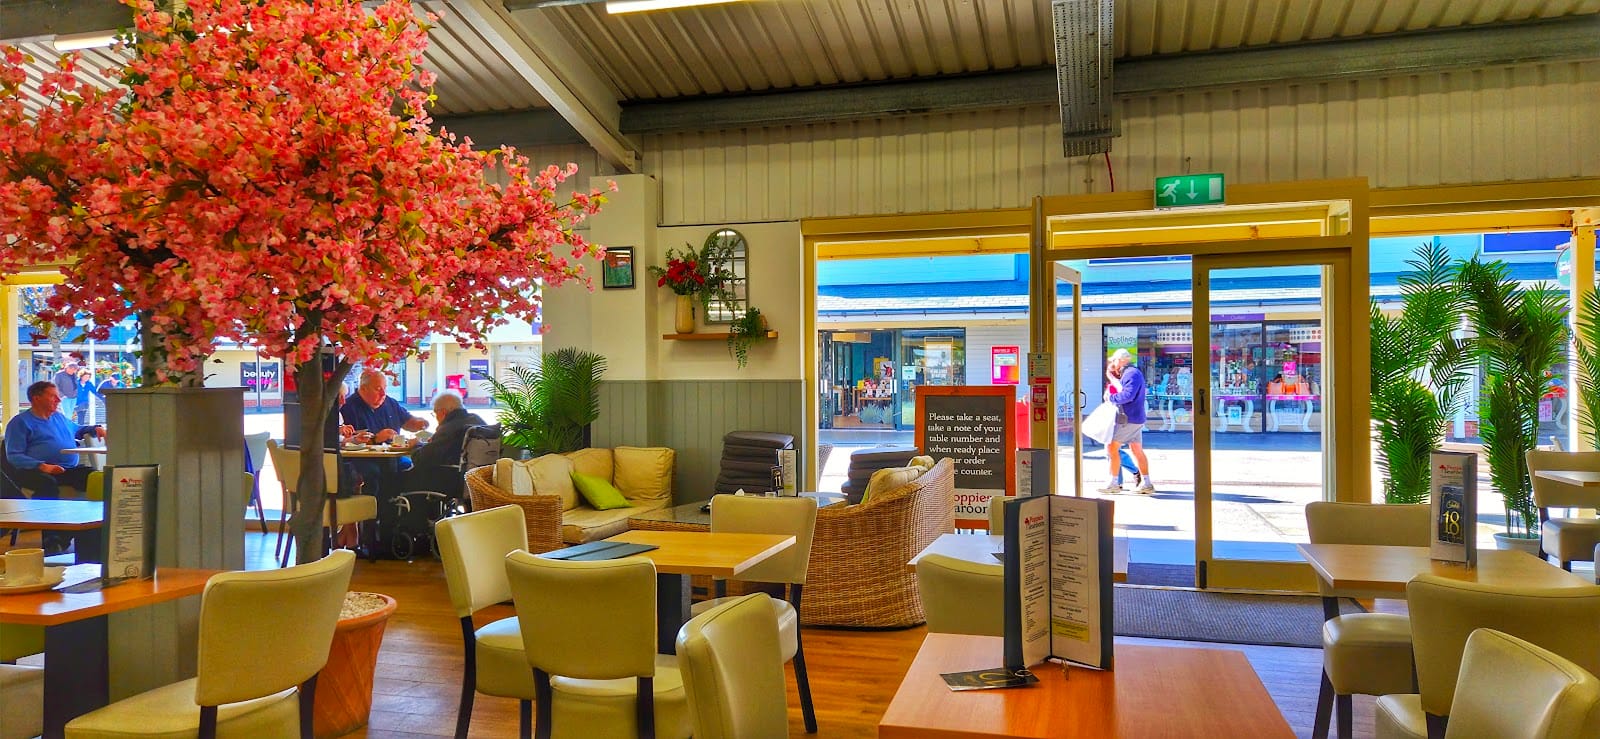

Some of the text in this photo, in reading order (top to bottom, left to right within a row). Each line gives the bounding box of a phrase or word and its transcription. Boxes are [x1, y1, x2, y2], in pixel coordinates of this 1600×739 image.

[243, 370, 275, 379] beuty
[929, 413, 955, 421] Please
[956, 413, 973, 421] take
[982, 414, 1001, 422] seat,
[927, 424, 944, 432] take
[974, 424, 983, 432] of
[983, 426, 1003, 434] your
[929, 434, 1001, 443] table number and
[929, 445, 1000, 455] when ready place
[963, 456, 986, 465] order
[954, 492, 992, 506] oppie
[1442, 510, 1460, 535] 18
